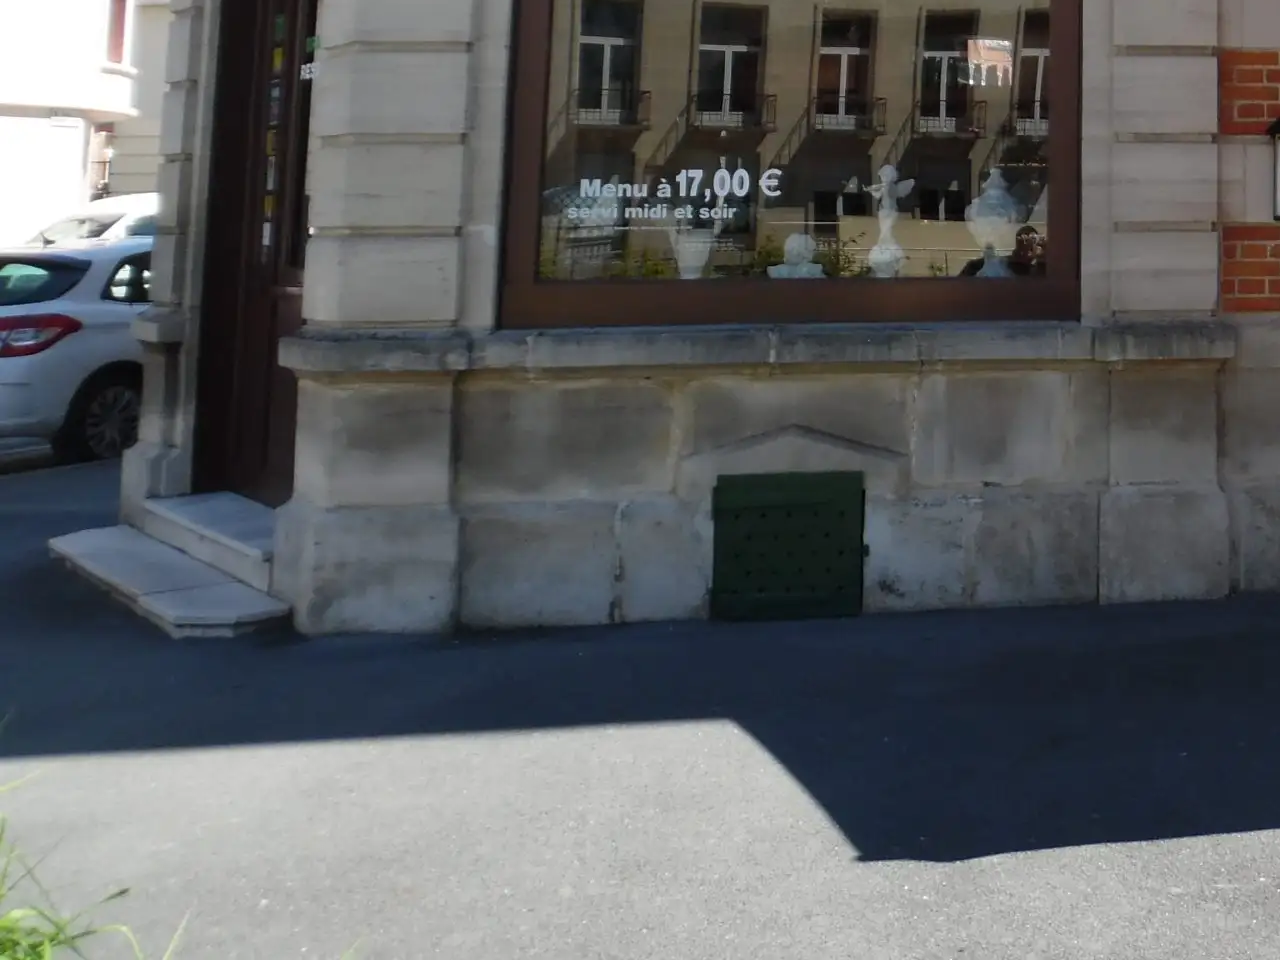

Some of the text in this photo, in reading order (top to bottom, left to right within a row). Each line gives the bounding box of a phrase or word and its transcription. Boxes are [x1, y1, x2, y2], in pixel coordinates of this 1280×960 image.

[579, 168, 782, 202] Menu à 17,00 €
[567, 204, 737, 219] servi midi et soir
